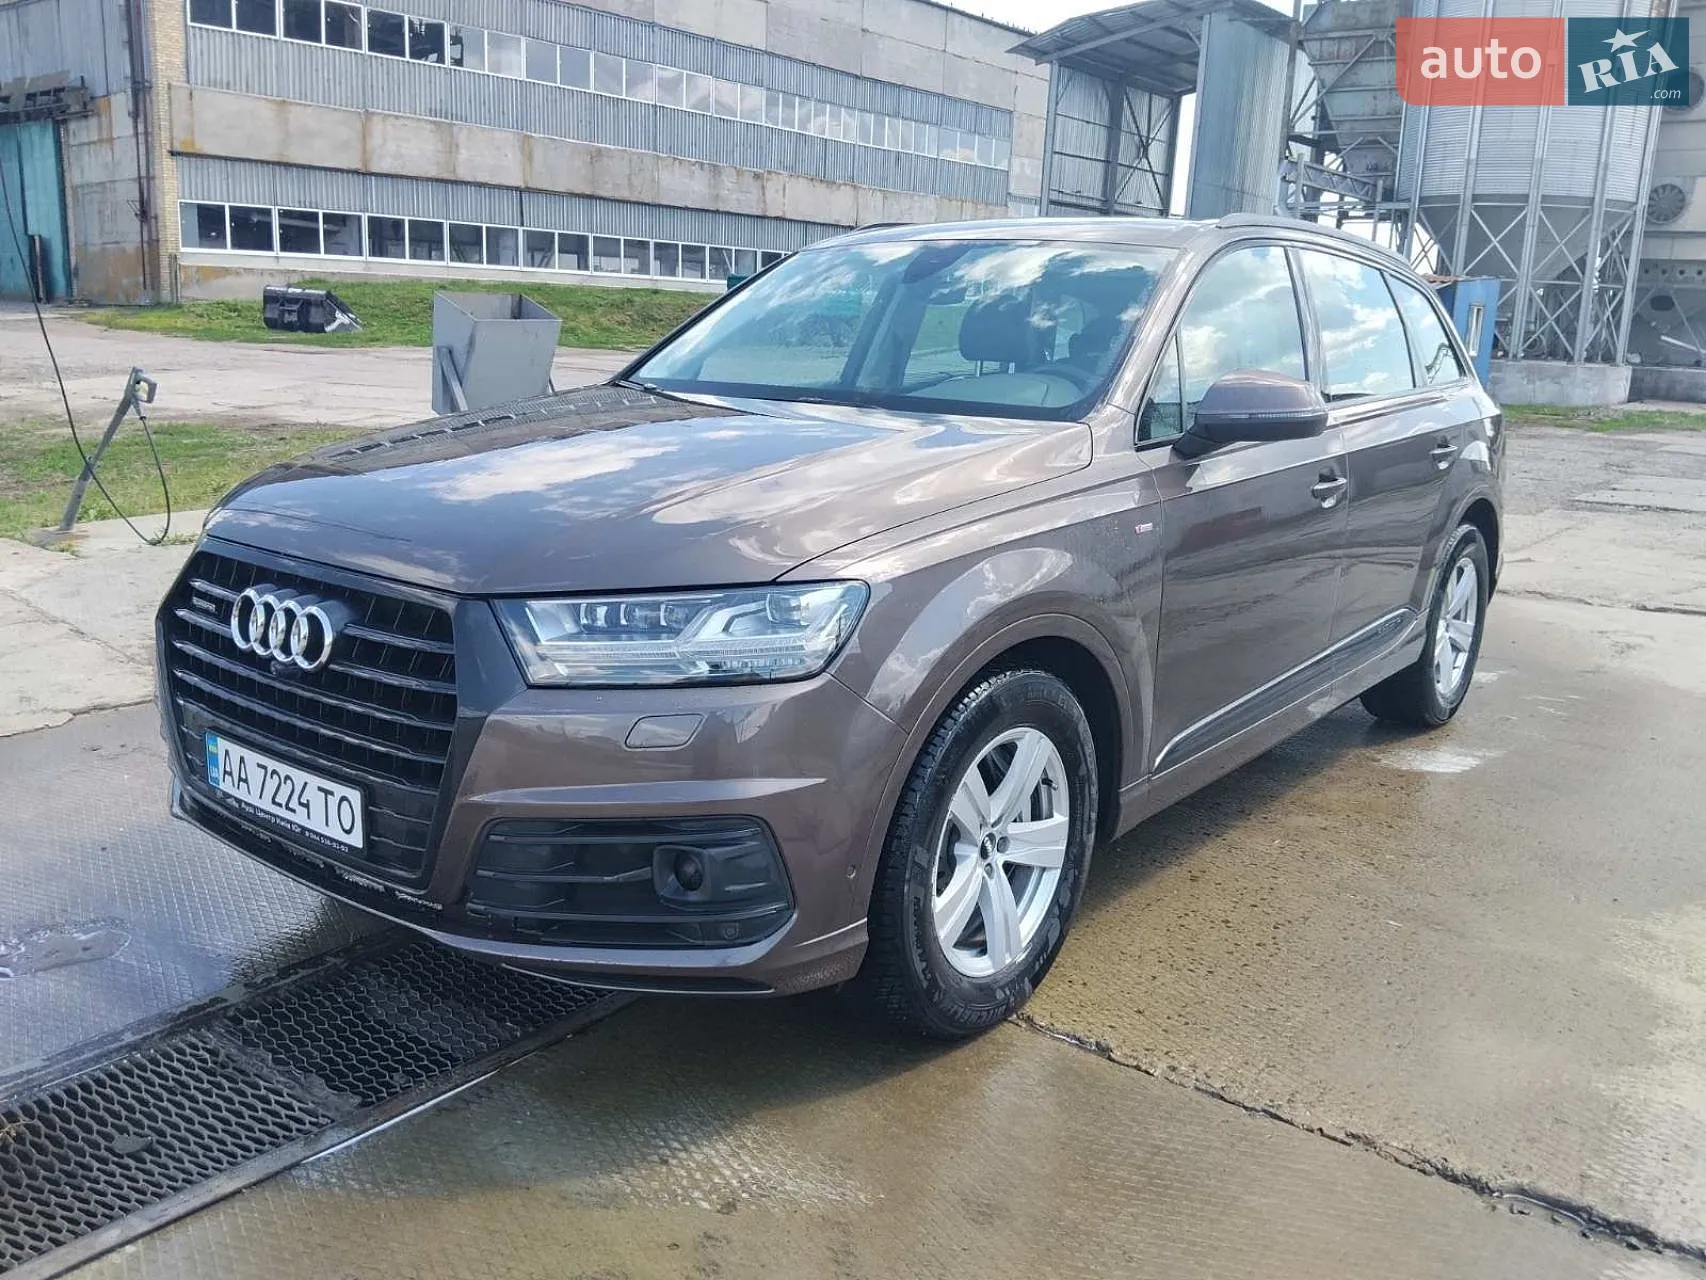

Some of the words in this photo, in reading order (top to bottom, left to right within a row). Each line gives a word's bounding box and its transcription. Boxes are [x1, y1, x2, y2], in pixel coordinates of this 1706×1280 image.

[222, 749, 251, 796] AA
[256, 762, 311, 820] 7224
[317, 785, 356, 835] TO
